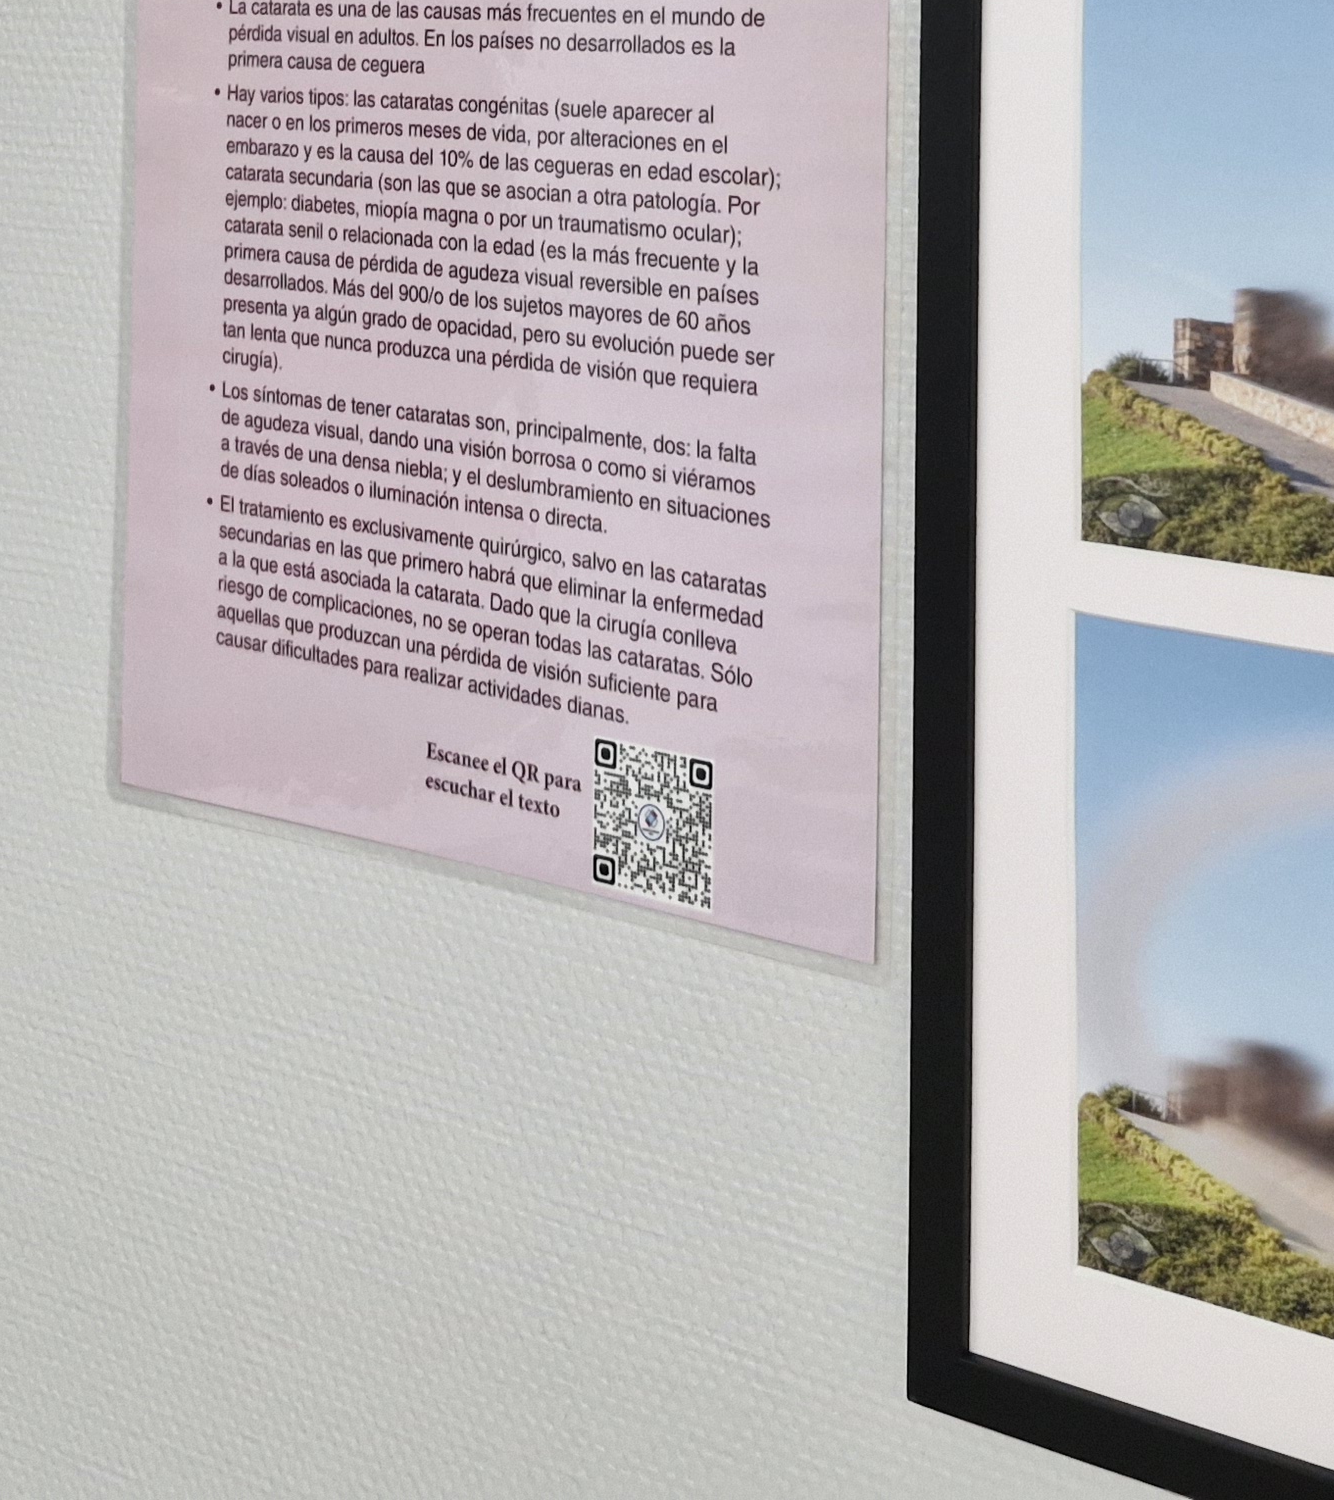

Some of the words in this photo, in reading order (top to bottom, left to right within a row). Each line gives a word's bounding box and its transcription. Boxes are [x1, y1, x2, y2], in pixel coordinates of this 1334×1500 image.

[228, 54, 283, 70] primera
[287, 56, 332, 70] causa
[337, 54, 356, 72] de
[361, 58, 425, 77] ceguera
[227, 84, 255, 106] Hay
[260, 90, 304, 104] varios
[309, 89, 344, 109] tipos:
[353, 90, 375, 108] las
[380, 93, 454, 112] cataratas
[459, 96, 549, 118] congénitas
[555, 98, 607, 120] (suele
[613, 105, 693, 124] aparecer
[698, 105, 714, 124] al
[225, 192, 283, 212] ejemplo:
[291, 194, 359, 217] diabetes,
[365, 202, 417, 222] miopía
[423, 207, 478, 228] magna
[484, 212, 494, 226] o
[500, 213, 527, 231] por
[532, 215, 553, 230] un
[558, 214, 667, 239] traumatismo
[673, 224, 741, 248] ocular);
[224, 268, 324, 294] desarrollados.
[333, 277, 365, 298] Más
[370, 282, 393, 300] del
[399, 284, 444, 305] 900/o
[449, 289, 469, 307] de
[475, 291, 498, 310] los
[504, 298, 563, 318] sujetos
[569, 304, 642, 325] mayores
[648, 308, 670, 327] de
[676, 310, 699, 330] 60
[705, 314, 751, 335] años
[222, 350, 278, 373] cirugía).
[221, 461, 239, 479] de
[243, 464, 275, 484] días
[281, 471, 349, 495] soleados
[354, 483, 364, 497] o
[369, 481, 459, 510] iluminación
[465, 498, 523, 521] intensa
[529, 508, 540, 523] o
[545, 507, 607, 533] directa.
[216, 632, 267, 652] causar
[271, 639, 359, 670] dificultades
[363, 659, 399, 678] para
[405, 666, 463, 690] realizar
[468, 679, 561, 710] actividades
[567, 696, 629, 724] dianas.
[425, 741, 490, 772] Escanee
[492, 756, 507, 776] el
[511, 760, 540, 785] QR
[543, 771, 582, 793] para
[424, 775, 496, 803] escuchar
[499, 788, 514, 808] el
[517, 793, 561, 818] texto
